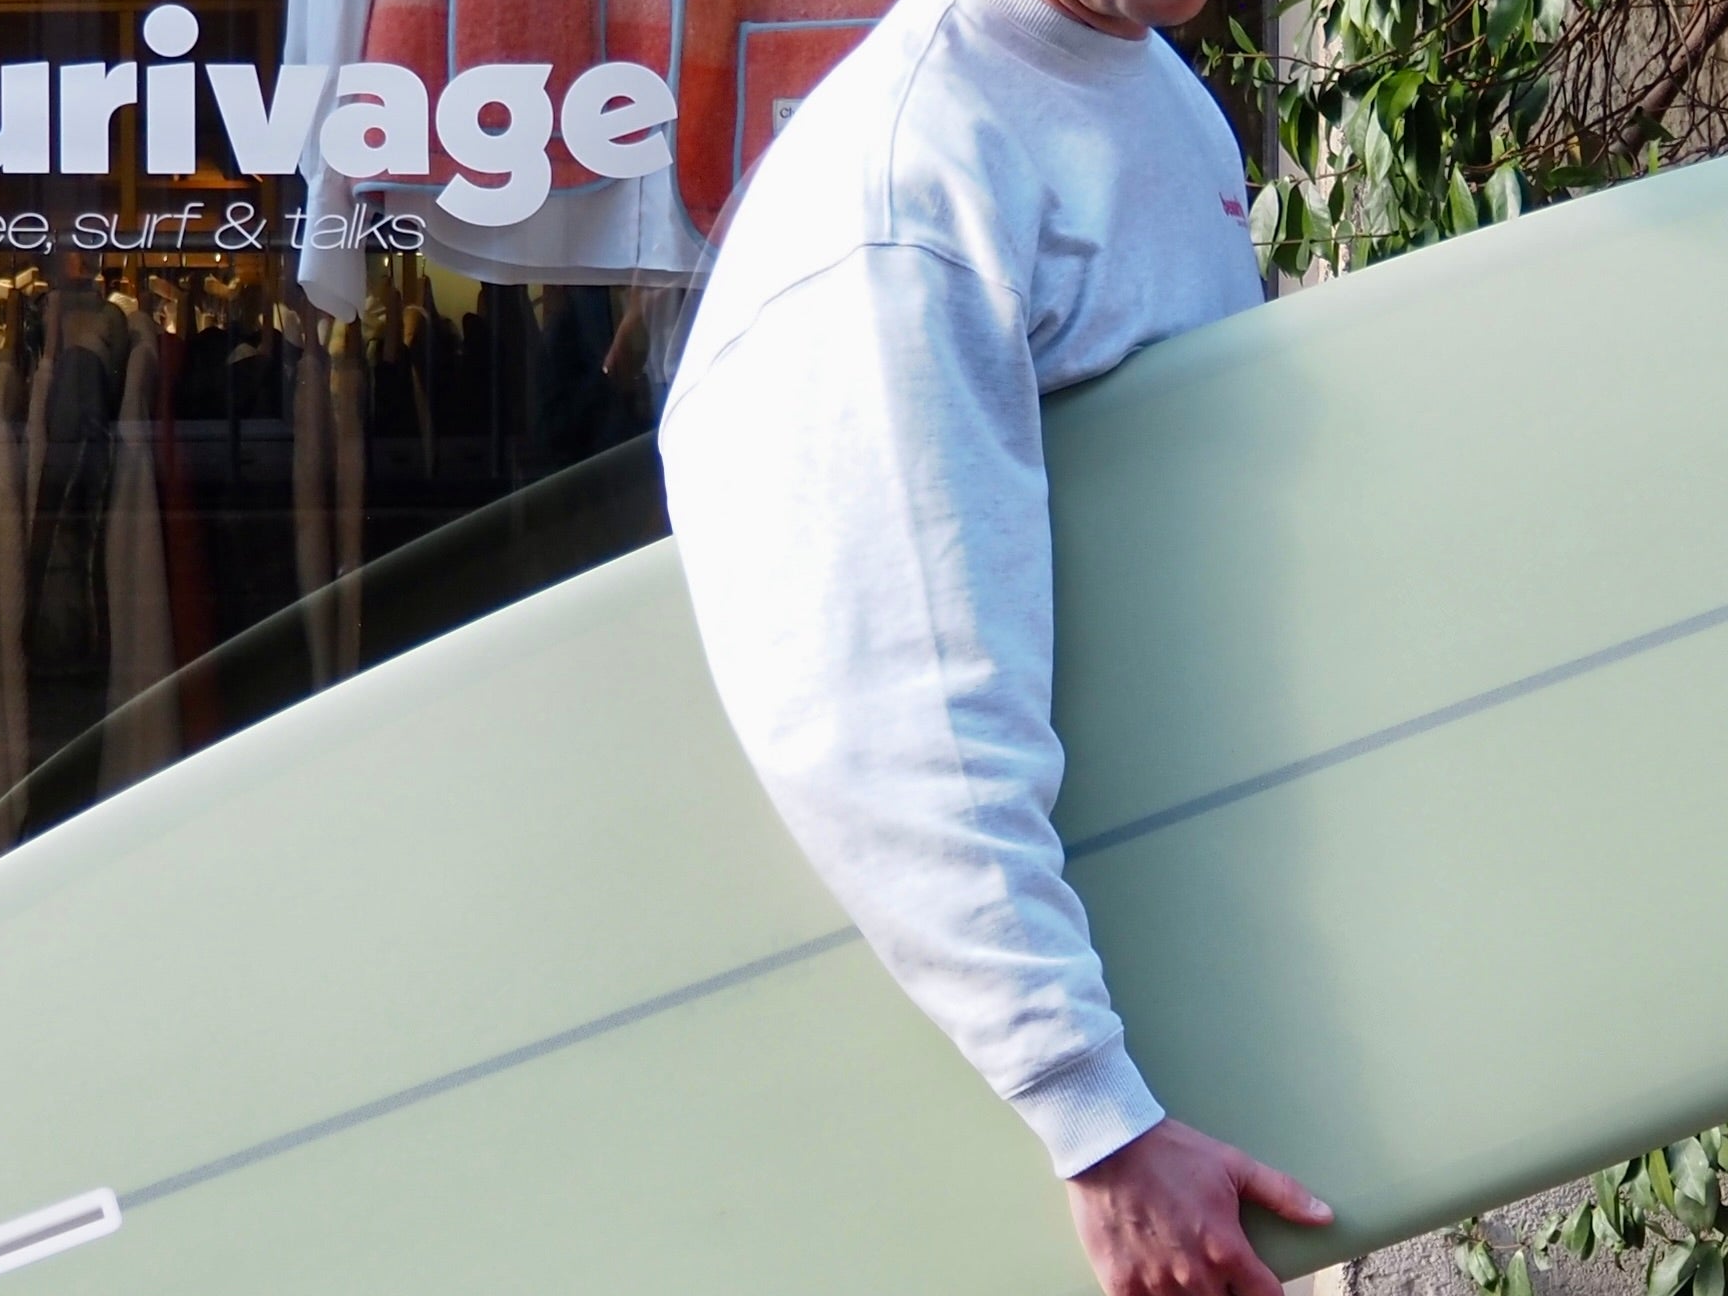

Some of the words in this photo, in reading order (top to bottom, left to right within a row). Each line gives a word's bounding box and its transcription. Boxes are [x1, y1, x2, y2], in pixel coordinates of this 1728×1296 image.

[73, 203, 205, 251] surf
[215, 204, 266, 251] &
[284, 203, 427, 251] talks
